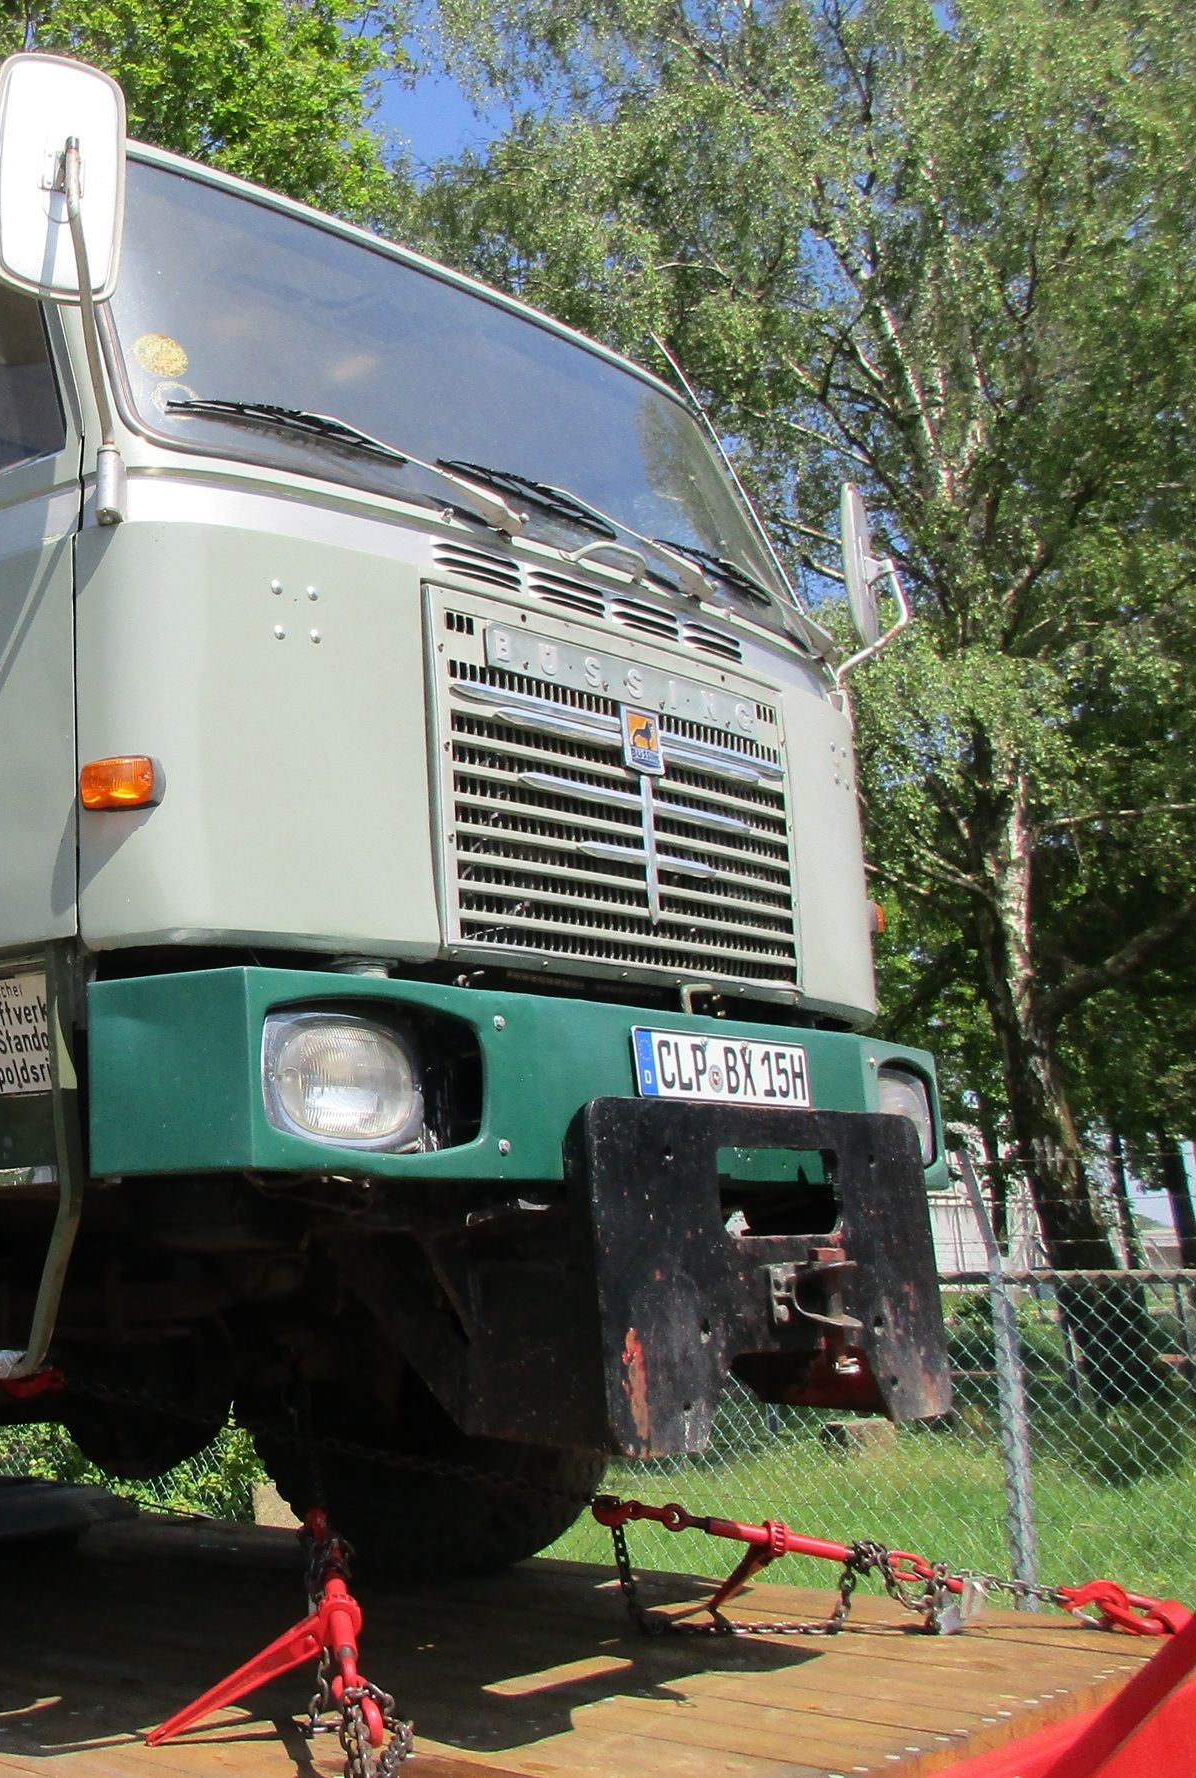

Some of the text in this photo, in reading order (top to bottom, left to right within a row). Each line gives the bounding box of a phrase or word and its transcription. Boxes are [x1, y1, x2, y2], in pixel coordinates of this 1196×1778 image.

[644, 1039, 806, 1100] D CLP BX 15H
